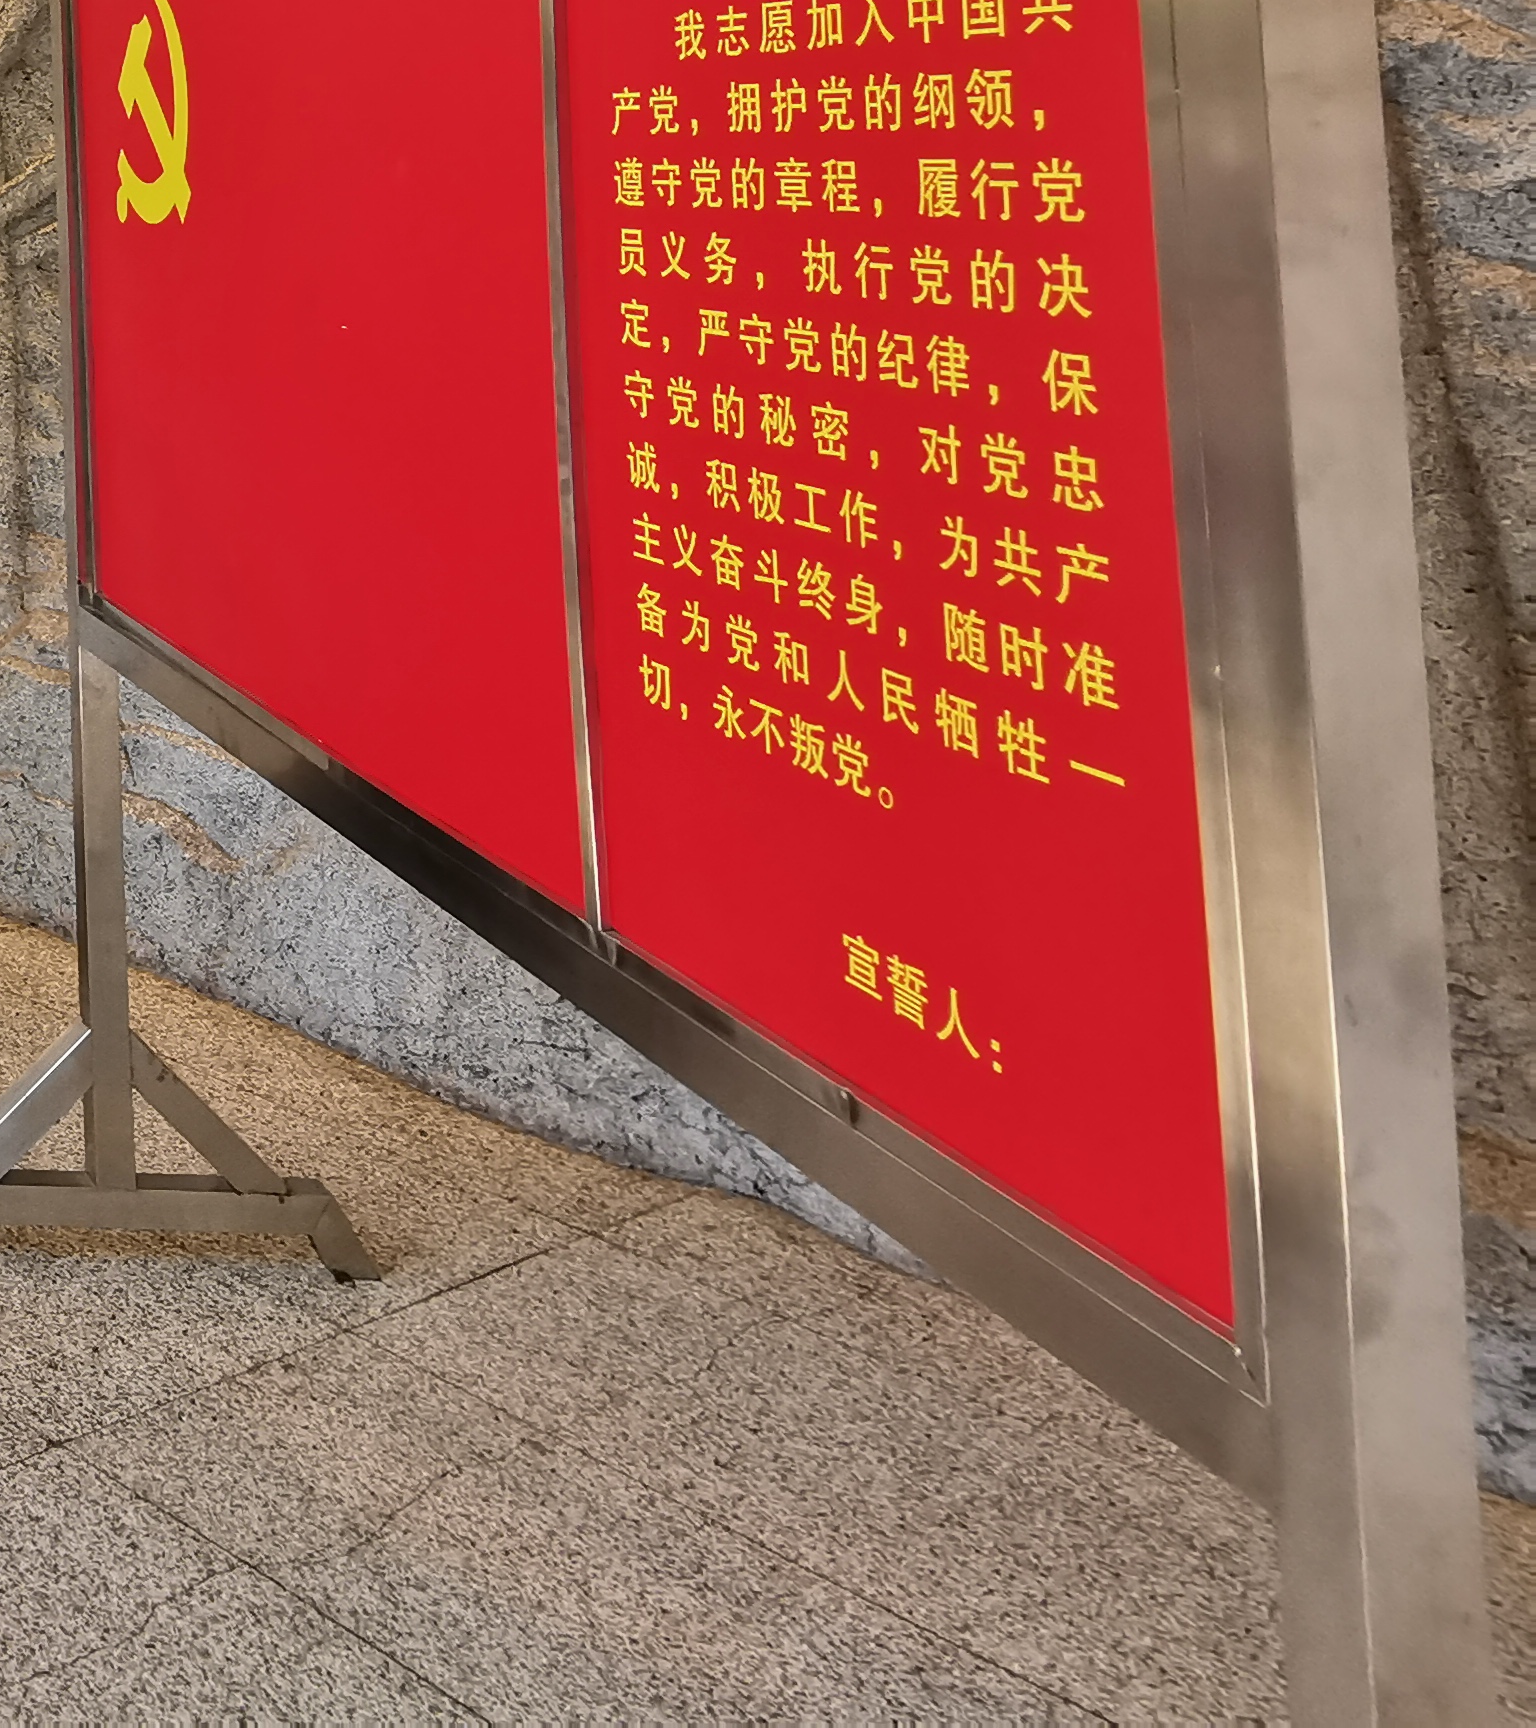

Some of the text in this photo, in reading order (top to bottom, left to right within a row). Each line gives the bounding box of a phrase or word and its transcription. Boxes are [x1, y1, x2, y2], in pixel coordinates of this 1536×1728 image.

[611, 68, 1046, 137] 产党，拥护党的纲领，
[614, 157, 1086, 223] 遵守党的章程，履行党
[618, 227, 1093, 319] 员义务，执行党的决
[620, 298, 1099, 416] 定，严守党的纪律，保
[623, 369, 1105, 512] 守党的秘密，对党忠
[626, 441, 1110, 604] 诚，积极工作，为共产
[632, 511, 1120, 710] 主义奋斗终身，随时准
[636, 582, 1126, 787] 备为党和人民牺牲一
[639, 653, 895, 810] 切，永不叛党。
[842, 933, 1004, 1074] 宣誓人：
